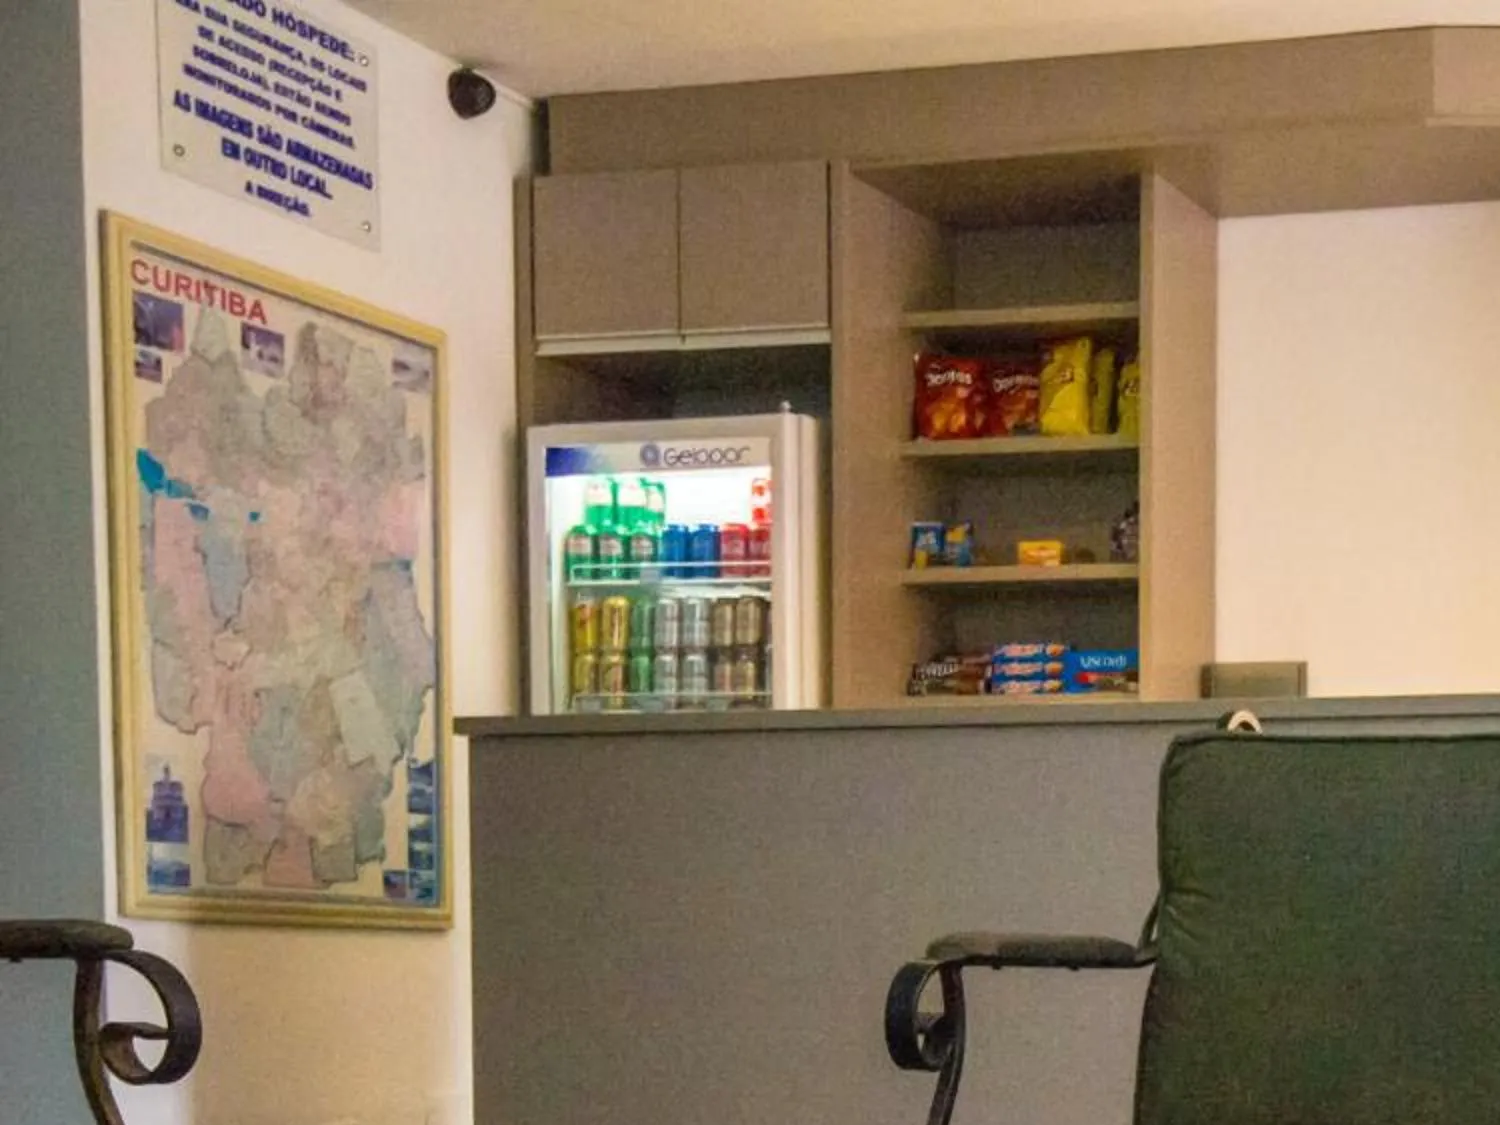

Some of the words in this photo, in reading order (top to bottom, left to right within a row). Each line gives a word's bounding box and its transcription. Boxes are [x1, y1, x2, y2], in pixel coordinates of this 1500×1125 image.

[173, 90, 191, 112] AS
[194, 98, 254, 139] IMAGENS
[257, 123, 283, 151] SÃO
[286, 137, 373, 190] ARMAZENADAS
[221, 136, 241, 160] EM
[243, 147, 287, 179] OUTRO
[130, 258, 268, 325] CURITIBA
